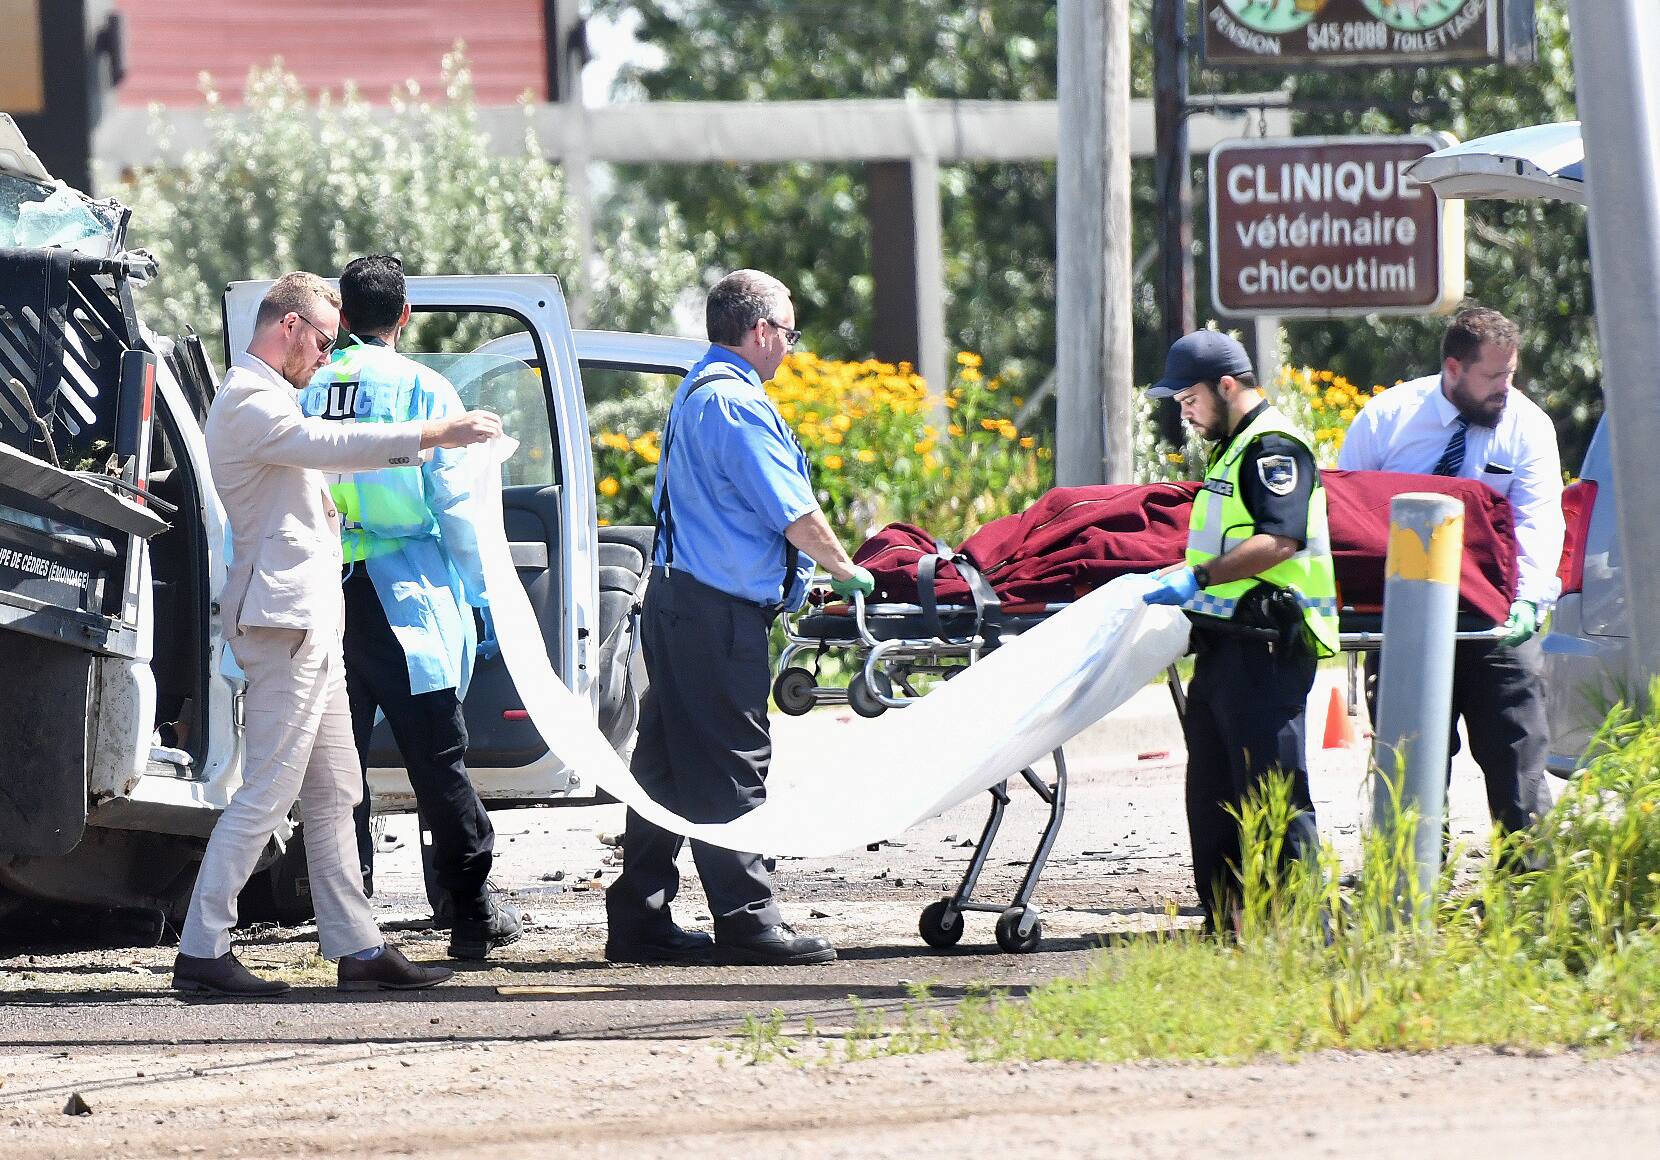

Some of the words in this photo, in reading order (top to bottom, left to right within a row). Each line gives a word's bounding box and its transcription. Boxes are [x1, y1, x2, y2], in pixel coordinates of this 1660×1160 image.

[1210, 5, 1281, 56] PENSION
[1392, 0, 1486, 52] TOILETTAG
[1227, 161, 1421, 205] CLINIQUE
[1236, 212, 1417, 248] vétérinaire
[1238, 257, 1417, 294] chicoutimi
[10, 551, 23, 569] DE
